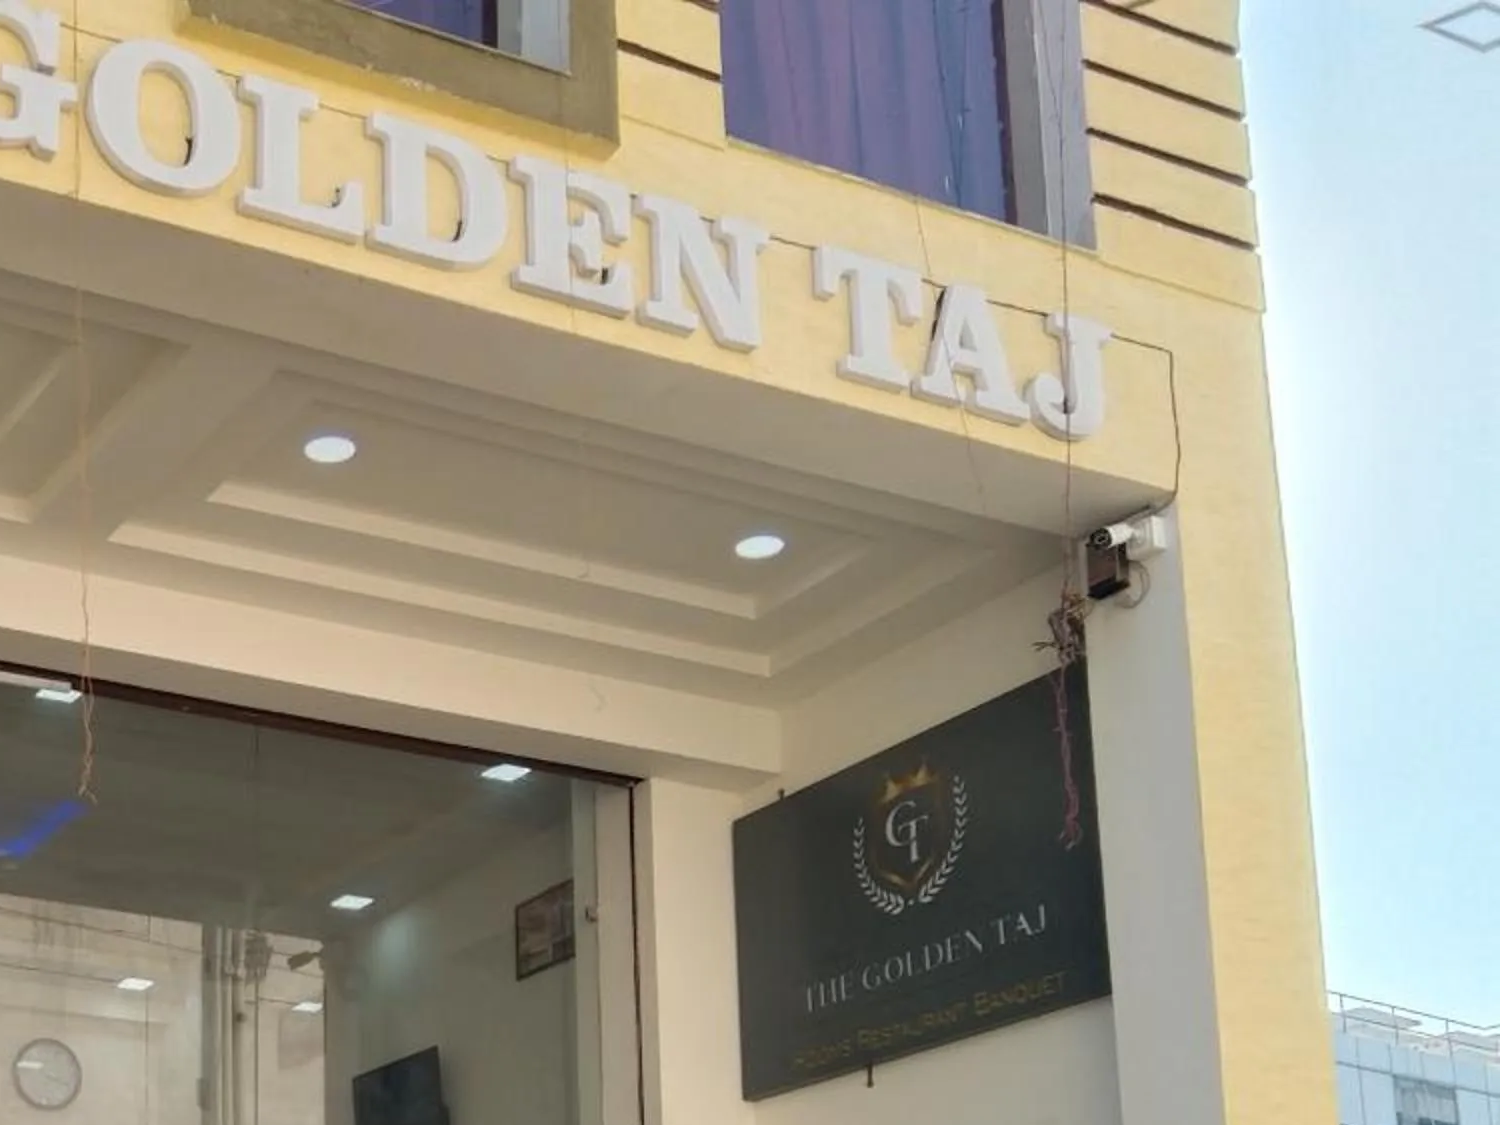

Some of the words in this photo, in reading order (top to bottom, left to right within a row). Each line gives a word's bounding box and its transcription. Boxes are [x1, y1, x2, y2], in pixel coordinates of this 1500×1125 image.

[813, 245, 1112, 441] TAJ
[804, 972, 856, 1013] THE
[861, 929, 984, 990] GOLDEN
[991, 904, 1048, 945] TAJ
